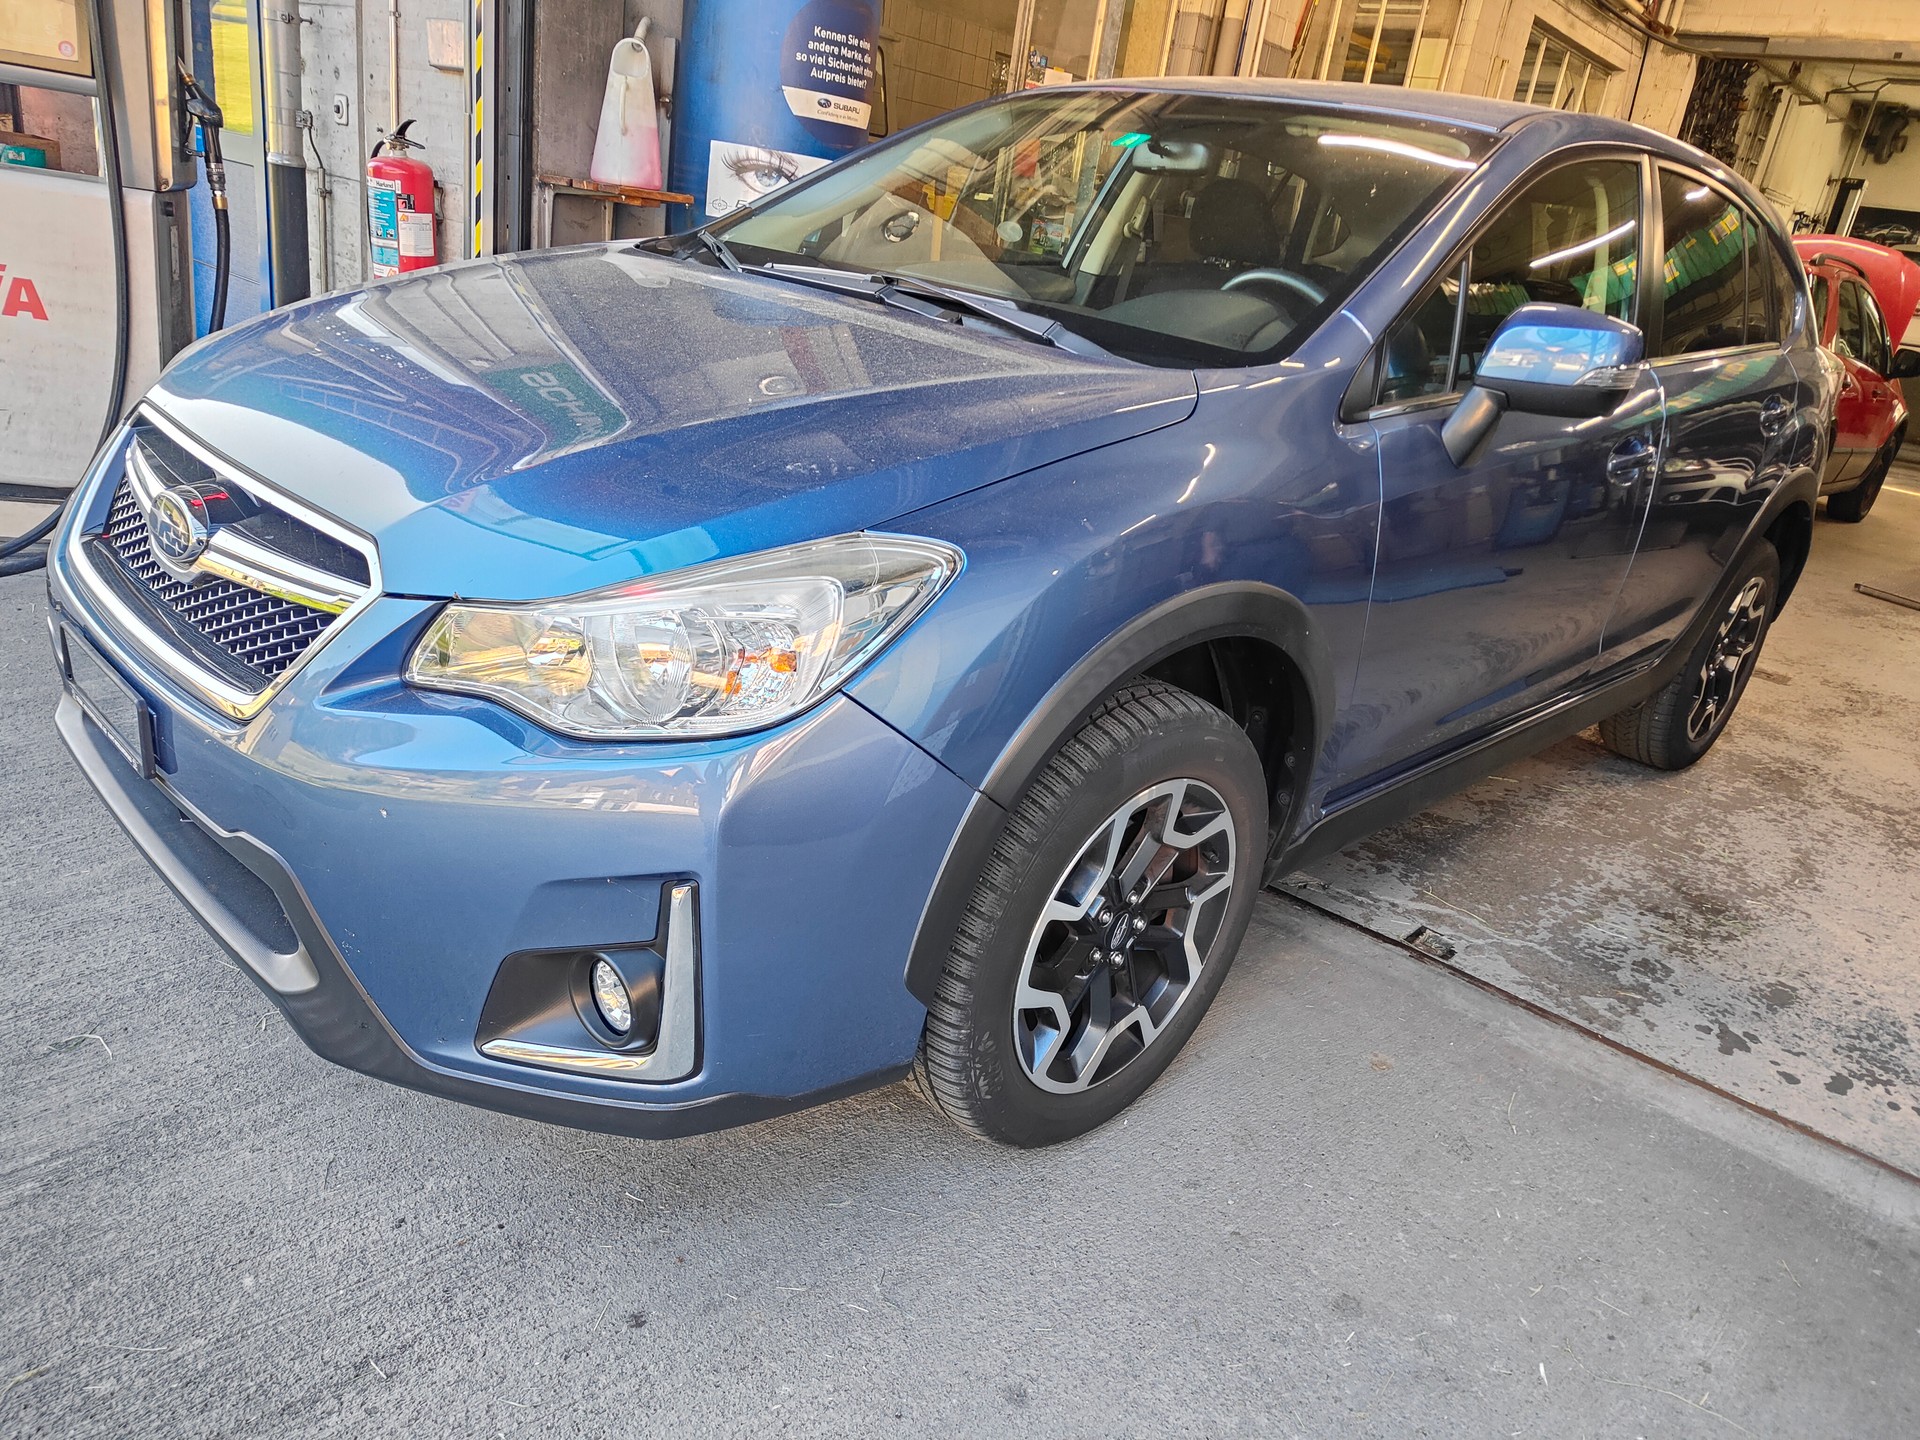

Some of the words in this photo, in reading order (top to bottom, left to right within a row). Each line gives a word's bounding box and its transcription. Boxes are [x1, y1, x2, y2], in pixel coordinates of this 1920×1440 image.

[814, 26, 846, 43] Kennen
[848, 34, 858, 47] Sie
[808, 40, 839, 55] andere
[840, 46, 863, 63] Marke,
[795, 52, 807, 62] so
[809, 53, 826, 66] viel
[827, 55, 863, 75] Sicherheit
[810, 67, 846, 83] Aufpreis
[847, 75, 867, 90] bietet?
[834, 103, 860, 114] SUBARU
